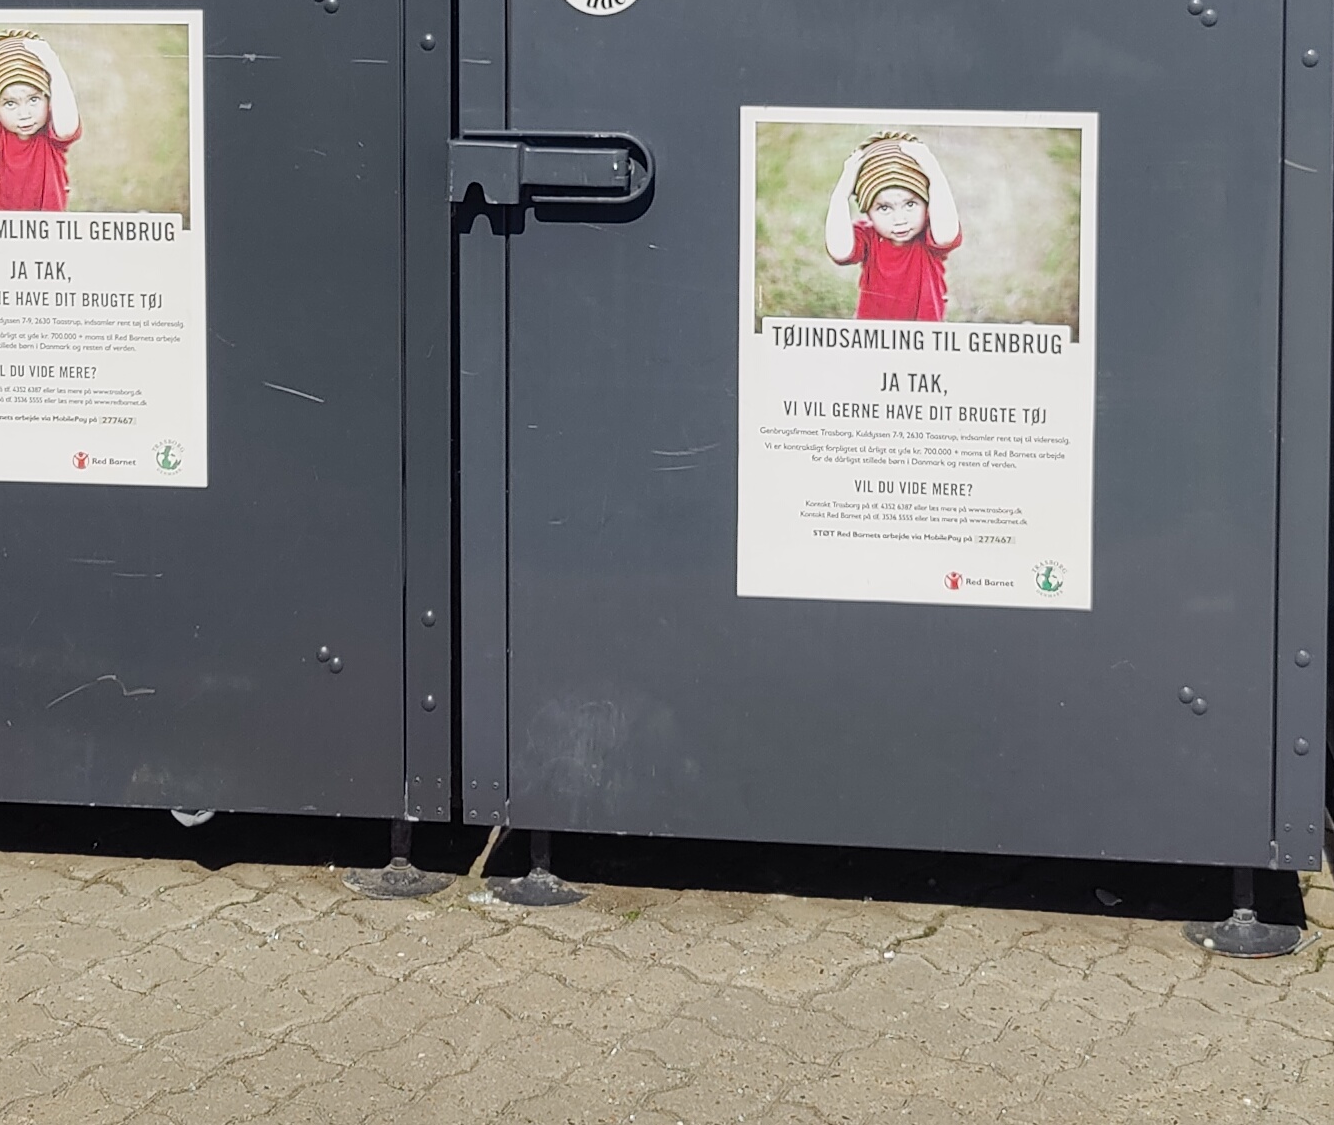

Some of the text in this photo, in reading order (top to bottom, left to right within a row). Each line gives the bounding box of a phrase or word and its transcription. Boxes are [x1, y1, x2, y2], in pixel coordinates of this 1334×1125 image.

[55, 220, 83, 240] TIL
[89, 221, 175, 242] GENBRUG
[10, 260, 71, 283] JA TAK,
[15, 291, 49, 306] HAVE
[55, 291, 77, 307] DIT
[82, 292, 135, 308] BRUGTE
[139, 292, 162, 311] TØJ
[772, 325, 1062, 354] TØJINDSAMLING TIL GENBRUG
[10, 364, 25, 377] DU
[28, 365, 55, 378] VIDE
[59, 365, 97, 379] MERE?
[880, 372, 947, 396] JA TAK,
[783, 400, 1046, 426] VI VIL GERNE HAVE DIT BRUGTE TØJ
[91, 457, 136, 466] Red Barnet
[854, 479, 973, 497] VIL DU VIDE MERE?
[965, 577, 1014, 587] Red Barnet
